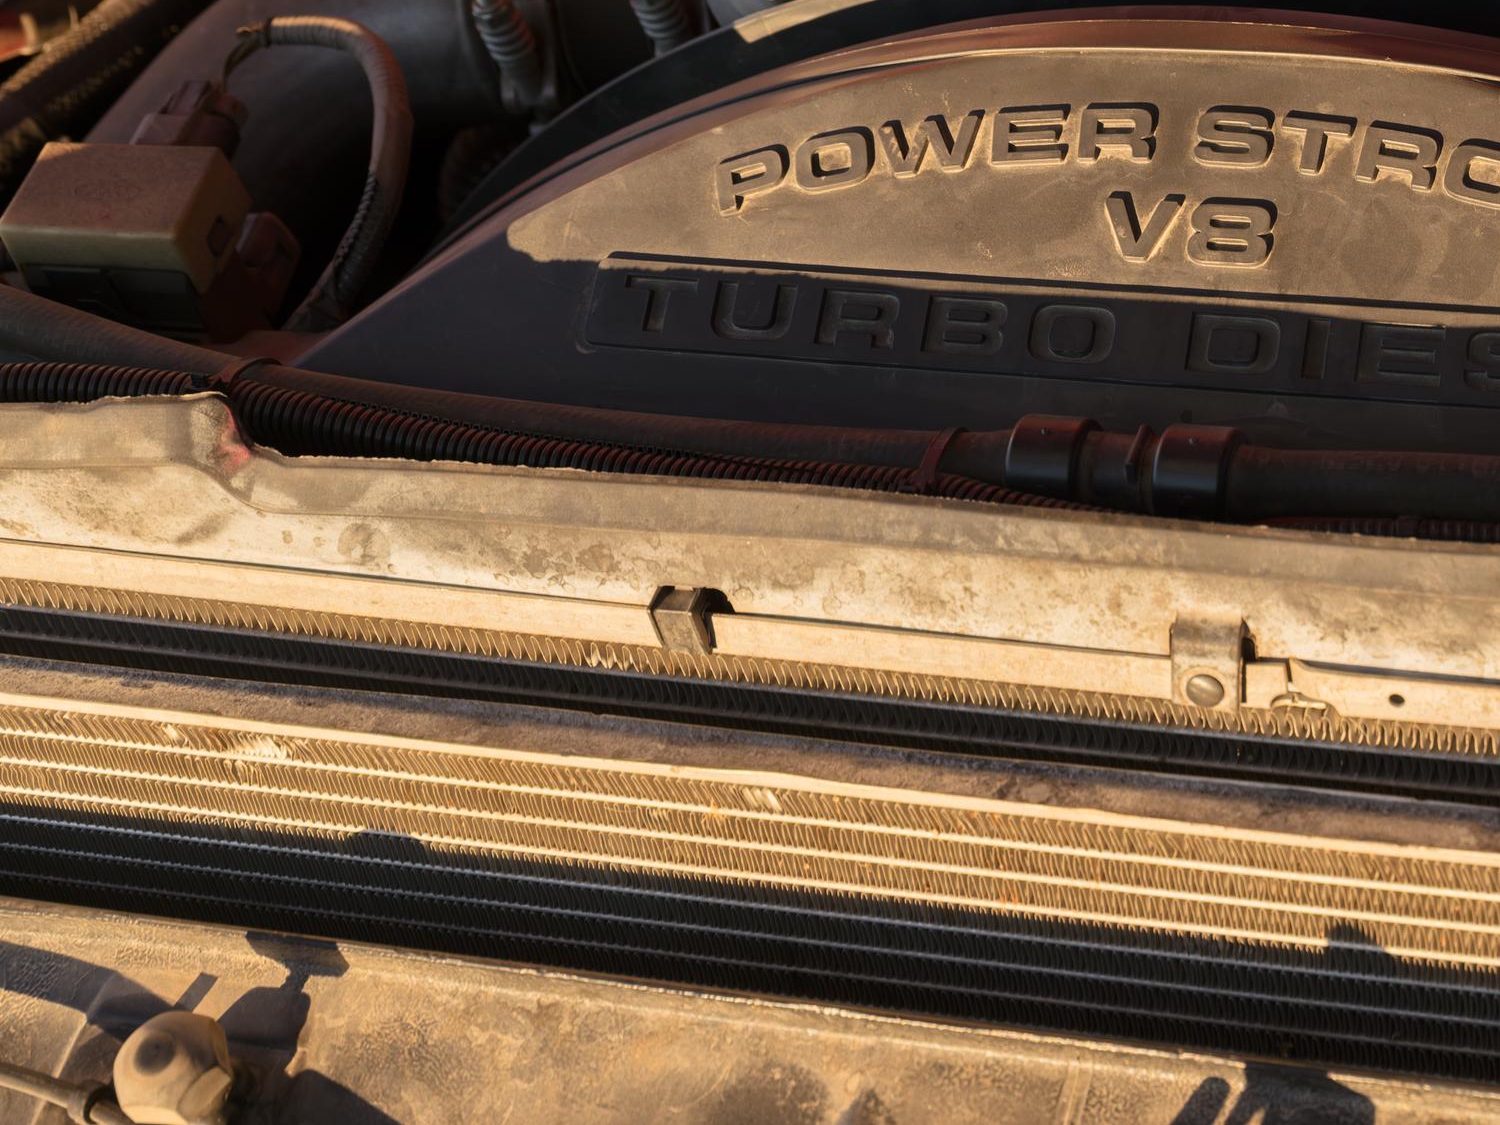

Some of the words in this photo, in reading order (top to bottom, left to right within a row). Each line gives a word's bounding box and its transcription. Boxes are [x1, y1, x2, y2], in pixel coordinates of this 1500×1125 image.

[714, 101, 1160, 217] POWER
[1104, 190, 1278, 269] V8
[625, 273, 1118, 364] TURBO
